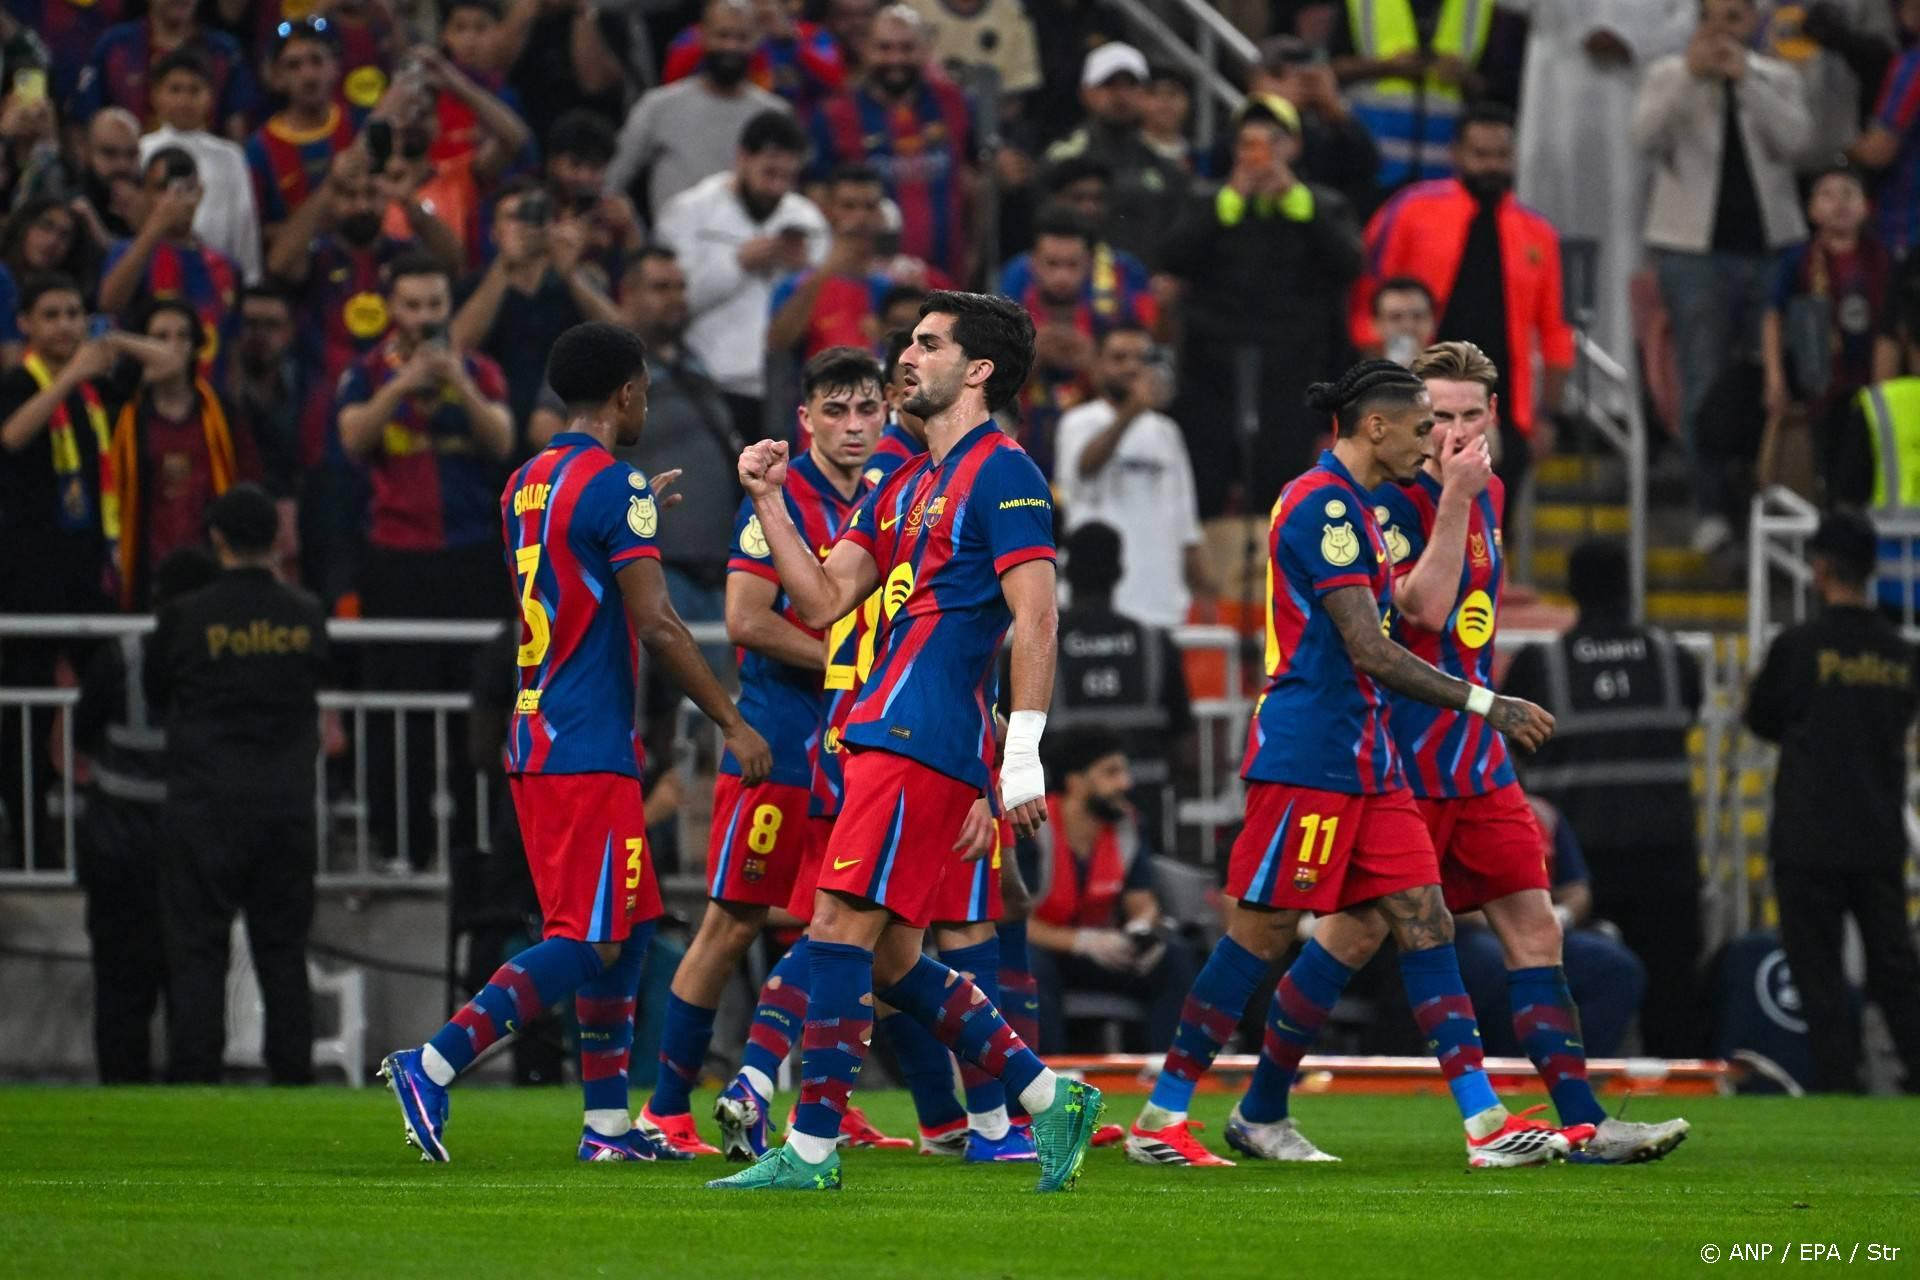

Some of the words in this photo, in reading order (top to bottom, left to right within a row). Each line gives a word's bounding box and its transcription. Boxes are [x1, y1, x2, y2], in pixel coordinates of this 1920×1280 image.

[514, 483, 552, 517] BALDE
[999, 498, 1046, 510] AMBILIGHT
[515, 543, 551, 667] 3
[206, 620, 311, 659] Police
[1064, 631, 1137, 658] Guard
[1572, 637, 1647, 663] Guard
[1593, 670, 1631, 700] 61
[1817, 648, 1912, 688] Police
[747, 804, 783, 854] 8
[1298, 813, 1340, 865] 11
[625, 837, 643, 889] 3
